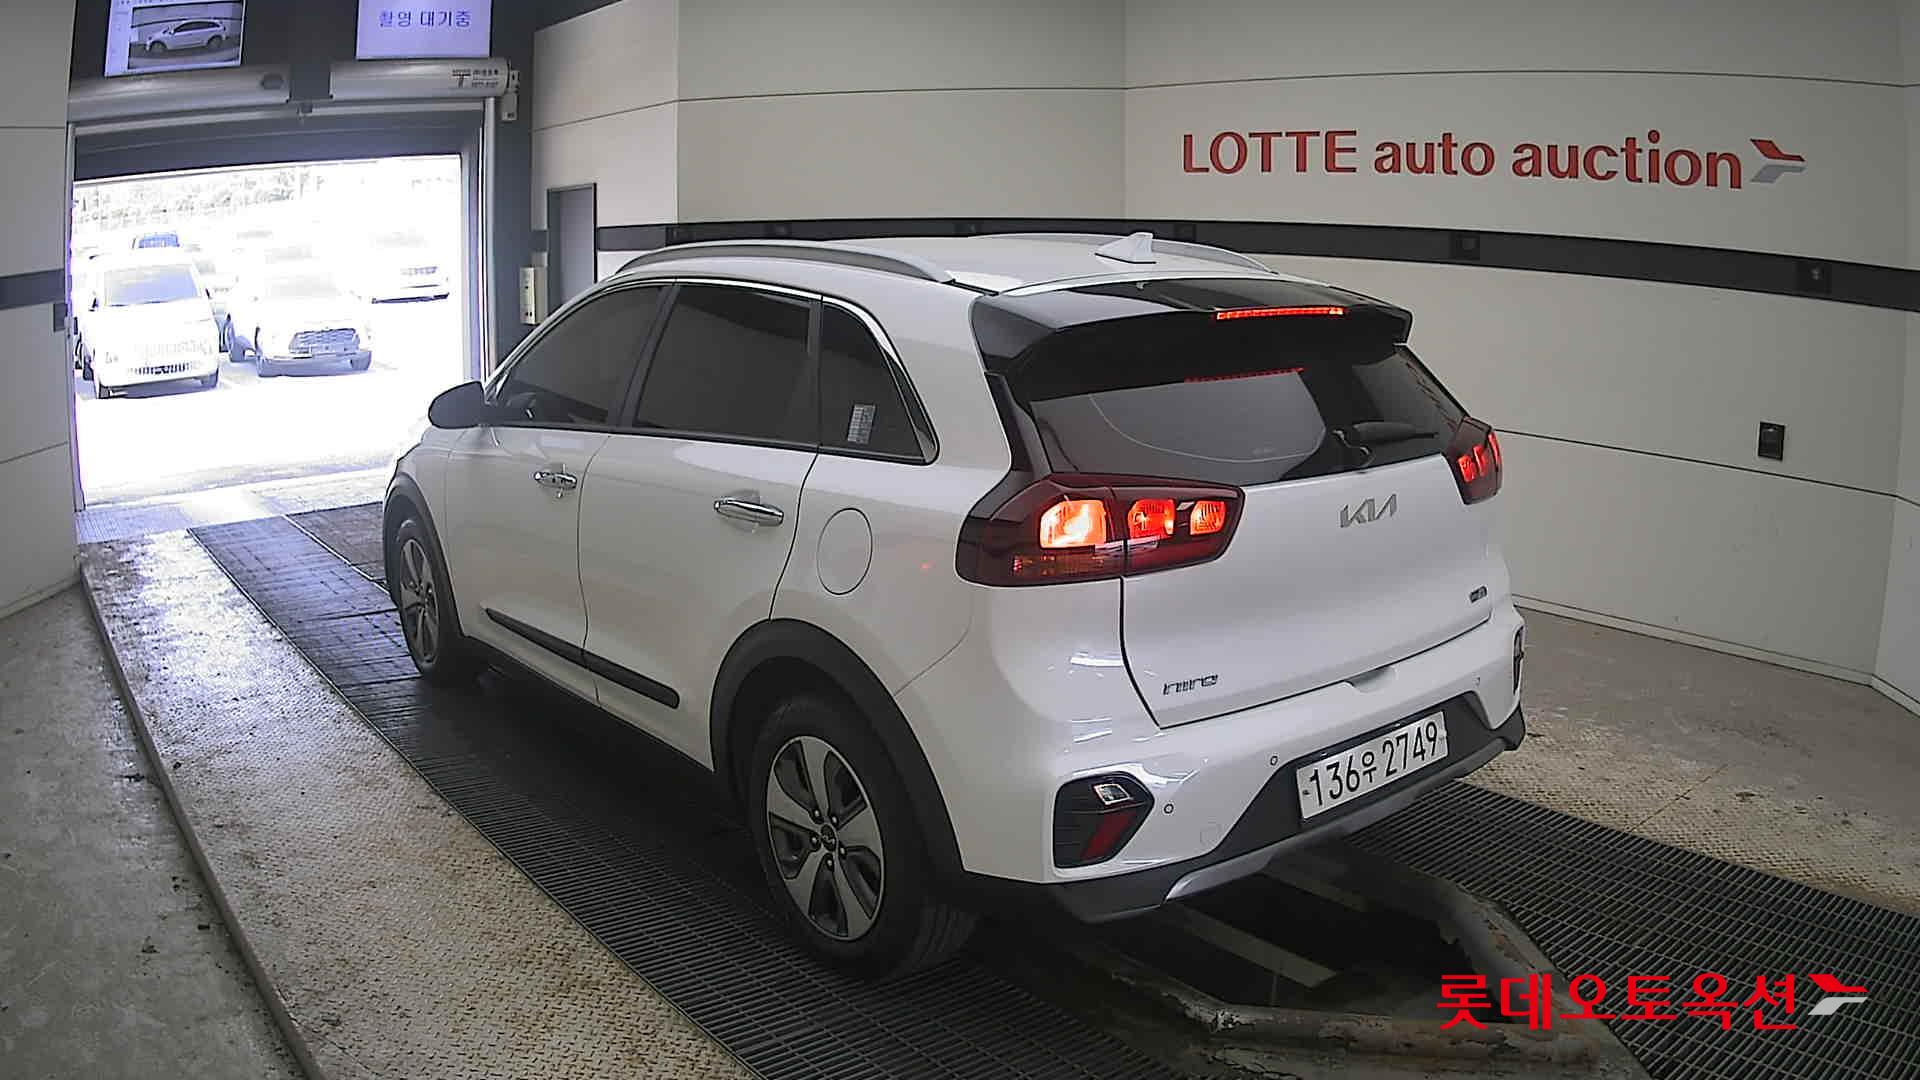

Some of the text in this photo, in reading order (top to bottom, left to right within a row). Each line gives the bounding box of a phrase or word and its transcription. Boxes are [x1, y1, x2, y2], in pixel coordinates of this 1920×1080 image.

[420, 10, 472, 27] 대기중
[1183, 129, 1743, 190] LOTTE auto auction
[1340, 493, 1397, 528] KIA
[1382, 721, 1438, 778] 2749
